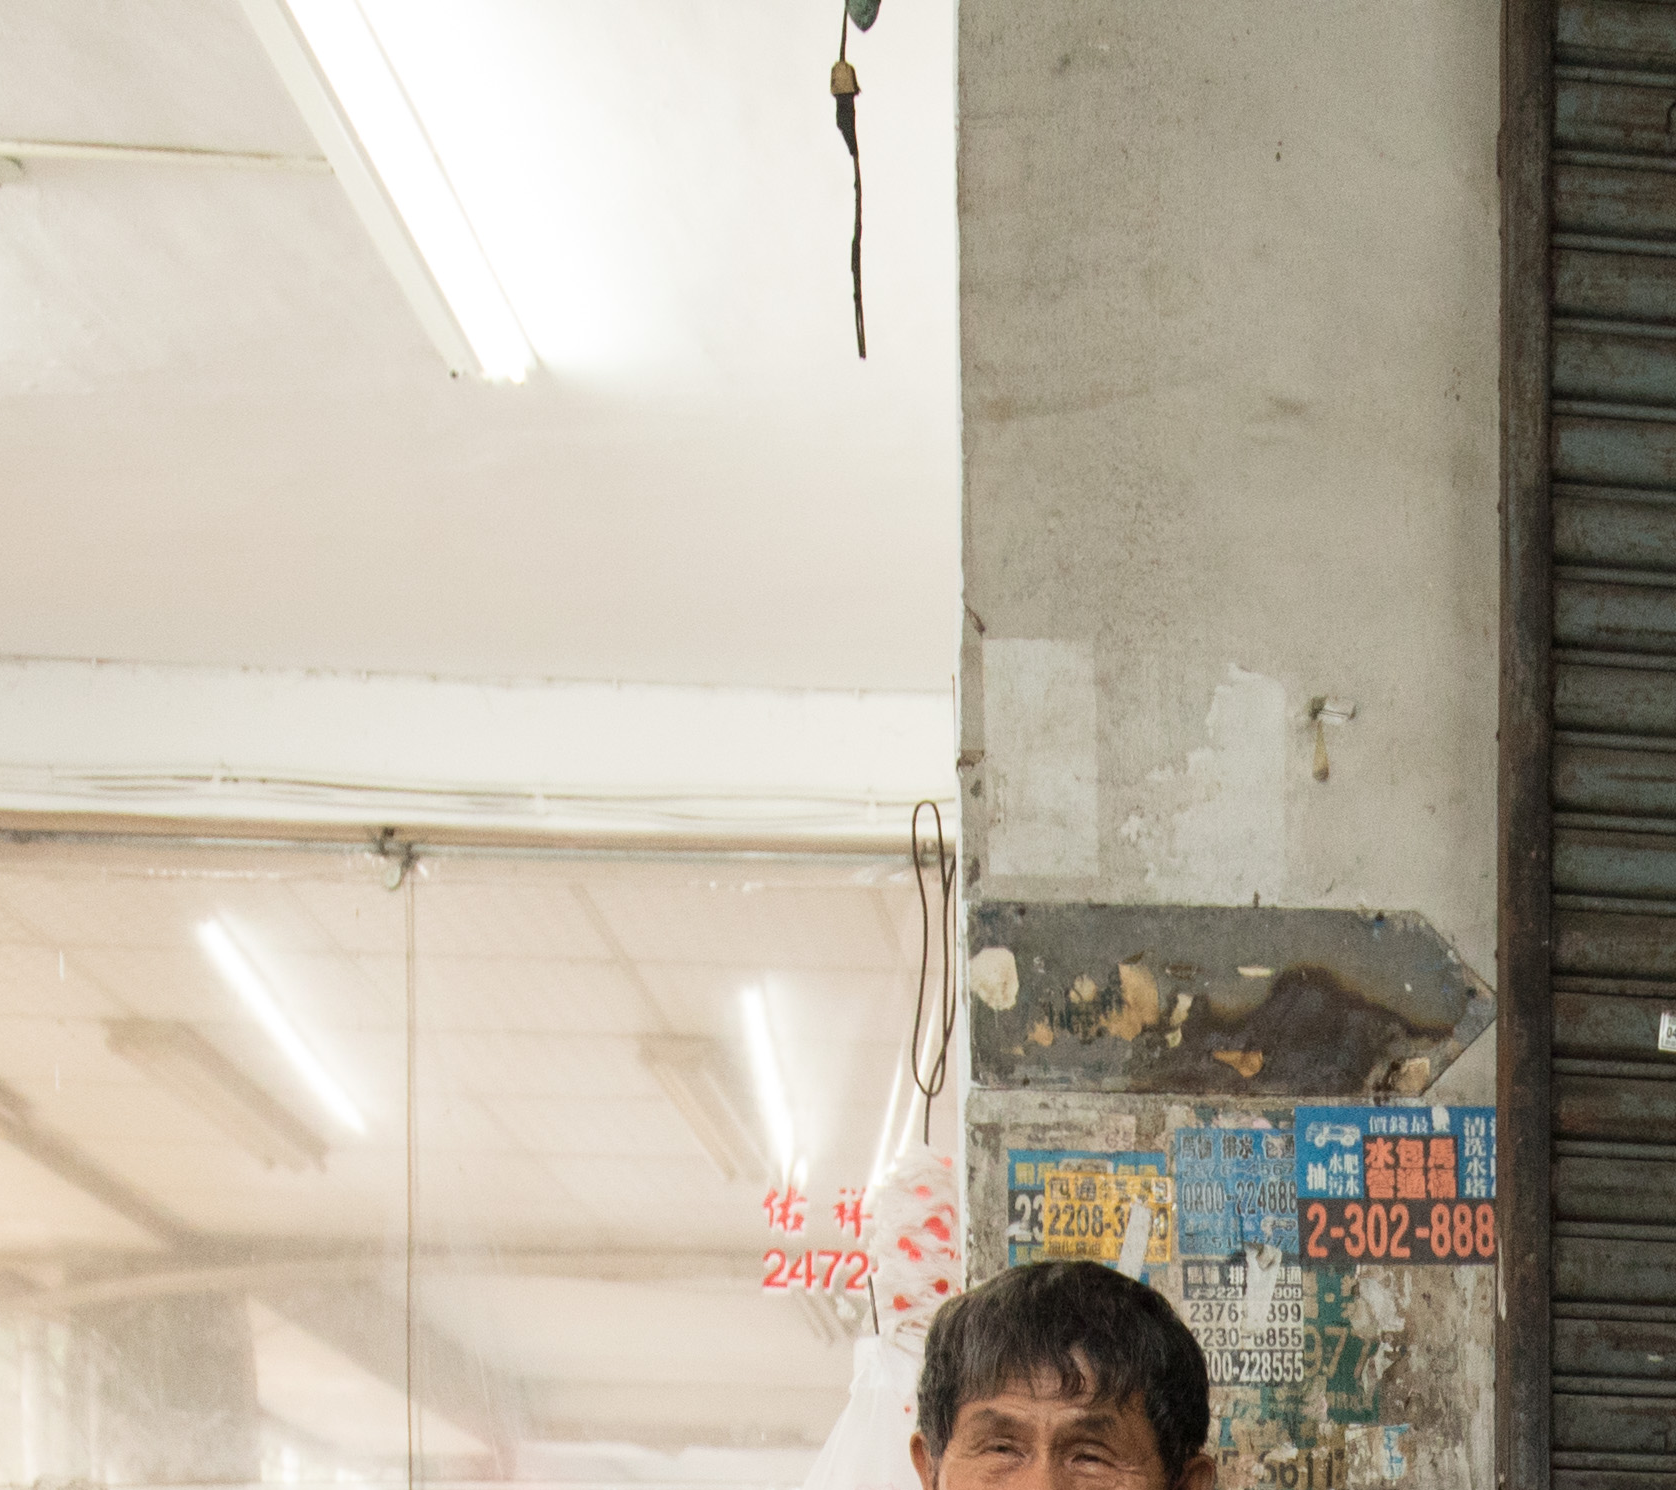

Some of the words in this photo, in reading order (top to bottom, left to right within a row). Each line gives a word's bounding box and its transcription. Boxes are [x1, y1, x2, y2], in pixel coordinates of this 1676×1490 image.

[1369, 1114, 1450, 1134] 價錢最
[1463, 1115, 1487, 1198] 清洗水塔
[1182, 1180, 1298, 1215] 0800-224888
[1048, 1203, 1170, 1241] 2208-30
[1306, 1201, 1496, 1258] 2-302-888
